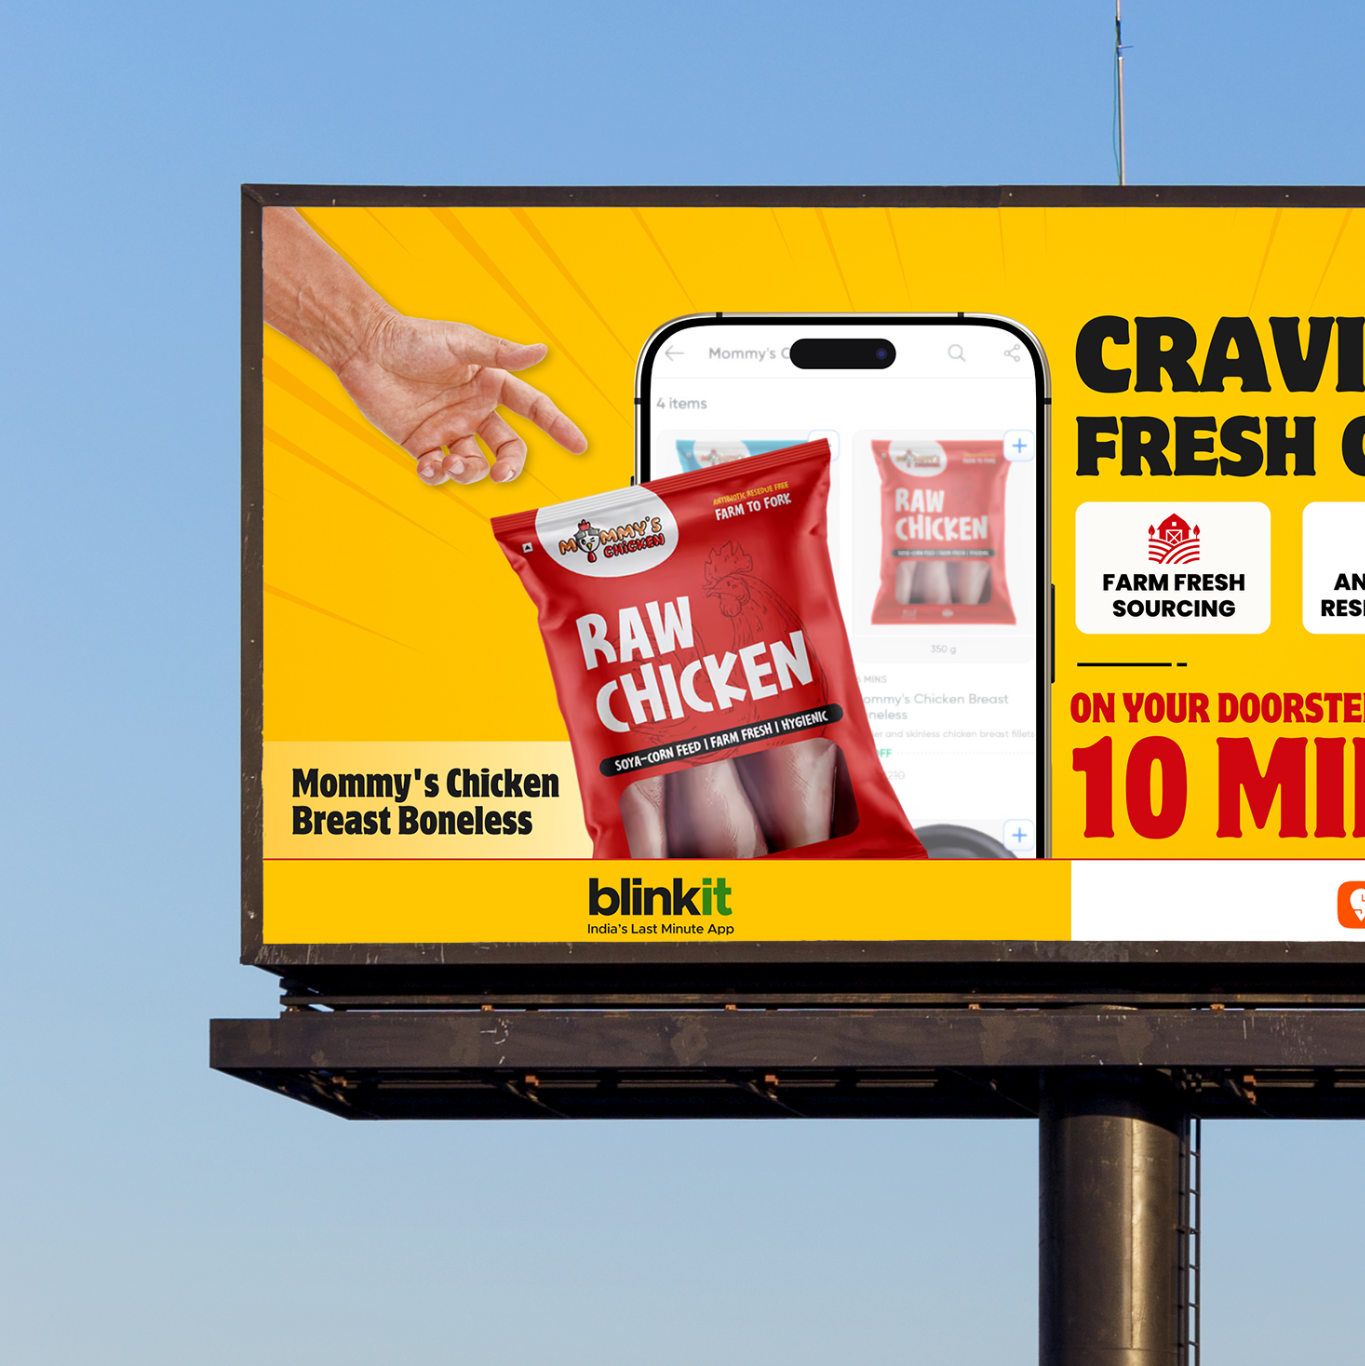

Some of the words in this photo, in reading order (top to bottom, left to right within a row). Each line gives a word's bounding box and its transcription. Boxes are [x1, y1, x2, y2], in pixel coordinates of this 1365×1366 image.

[708, 346, 777, 363] Mommy's
[656, 396, 666, 409] 4
[668, 396, 708, 410] items
[1075, 414, 1317, 478] FRESH
[773, 481, 789, 491] FREE
[715, 503, 745, 521] FARM
[746, 500, 761, 512] TO
[763, 493, 792, 509] FORK
[895, 487, 946, 513] RAW
[895, 514, 988, 541] CHICKEN
[1104, 574, 1169, 591] FARM
[1174, 574, 1245, 591] FRESH
[1112, 600, 1236, 618] SOURCING
[575, 596, 695, 671] RAW
[930, 645, 948, 654] 350
[949, 646, 957, 655] g
[596, 630, 814, 733] CHICKEN
[864, 675, 887, 683] MINS
[861, 694, 911, 707] ommy's
[913, 693, 965, 705] Chicken
[968, 693, 1010, 705] Breast
[1070, 692, 1116, 724] ON
[1122, 692, 1211, 724] YOUR
[867, 709, 908, 721] neless
[614, 746, 674, 772] SOYA-CORN
[676, 741, 702, 757] FEED
[710, 732, 740, 749] FARM
[742, 722, 773, 742] FRESH
[781, 710, 829, 731] HYGIENIC
[885, 730, 904, 738] and
[906, 730, 941, 738] skinless
[943, 730, 978, 738] chicken
[979, 730, 1010, 738] breast
[1011, 730, 1035, 738] fillets
[292, 768, 440, 803] Mommy's
[446, 768, 560, 798] Chicken
[1072, 735, 1188, 840] 10
[292, 806, 392, 836] Breast
[398, 805, 533, 836] Boneless
[588, 877, 733, 917] blinkit
[587, 923, 628, 934] India's
[631, 923, 658, 934] Last
[661, 923, 704, 934] Minute
[707, 923, 735, 936] App
